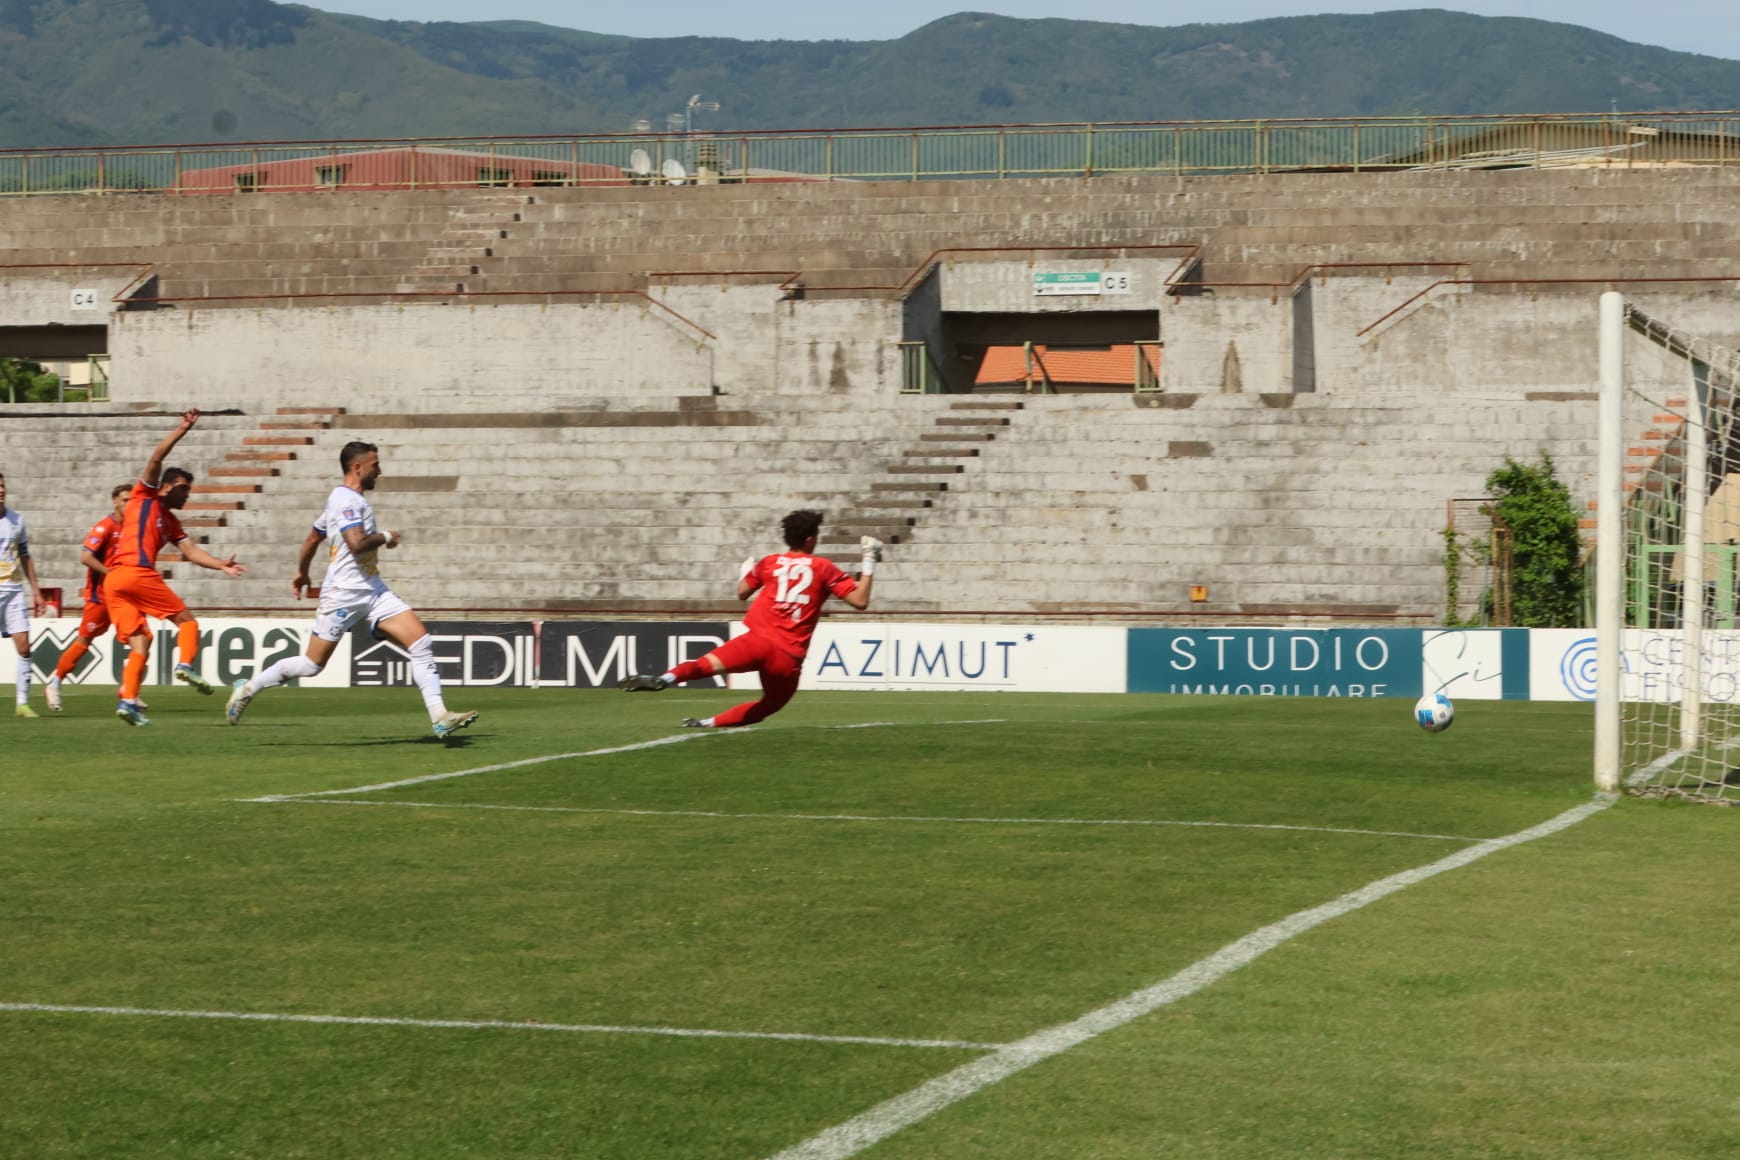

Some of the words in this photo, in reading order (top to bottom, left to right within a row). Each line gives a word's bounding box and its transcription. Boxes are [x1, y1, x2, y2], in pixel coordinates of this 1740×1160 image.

[772, 564, 814, 605] 12
[817, 639, 1017, 679] AZIMUT
[1169, 635, 1390, 671] STUDIO
